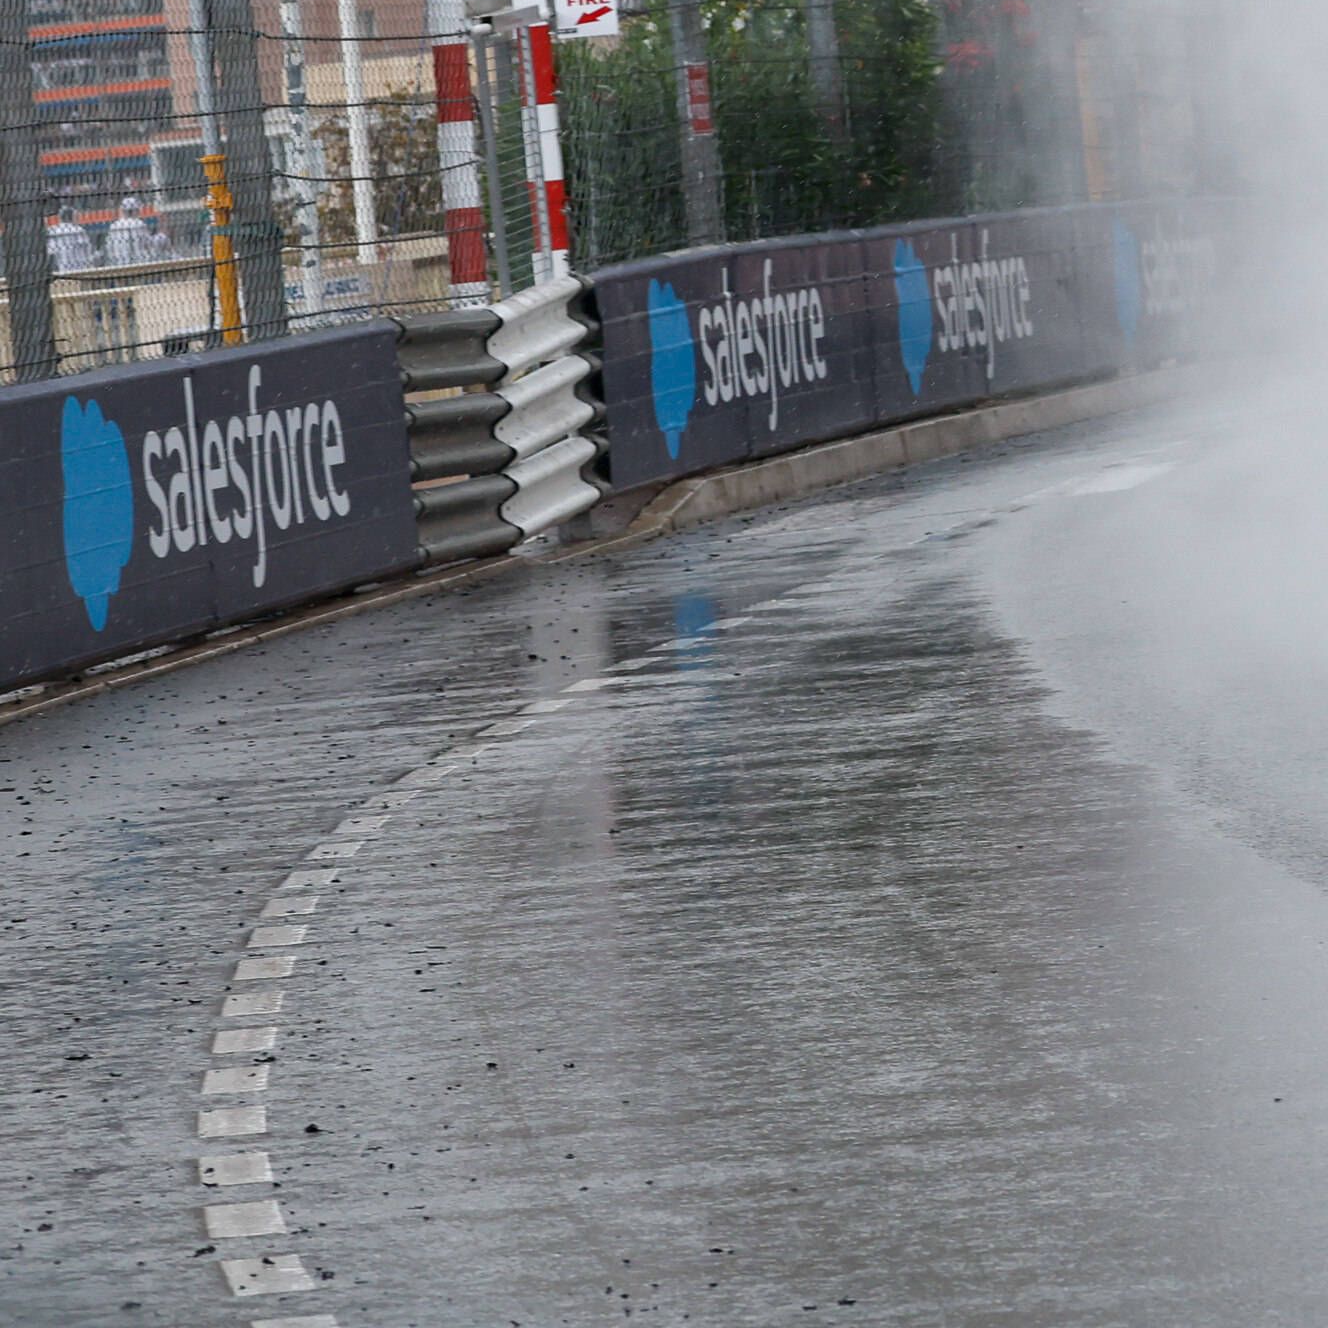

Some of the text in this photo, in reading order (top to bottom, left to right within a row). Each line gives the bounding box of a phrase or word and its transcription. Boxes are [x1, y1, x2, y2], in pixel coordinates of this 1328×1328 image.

[698, 258, 828, 432] salesforce
[933, 228, 1035, 380] salesforce
[142, 363, 351, 589] salesforce
